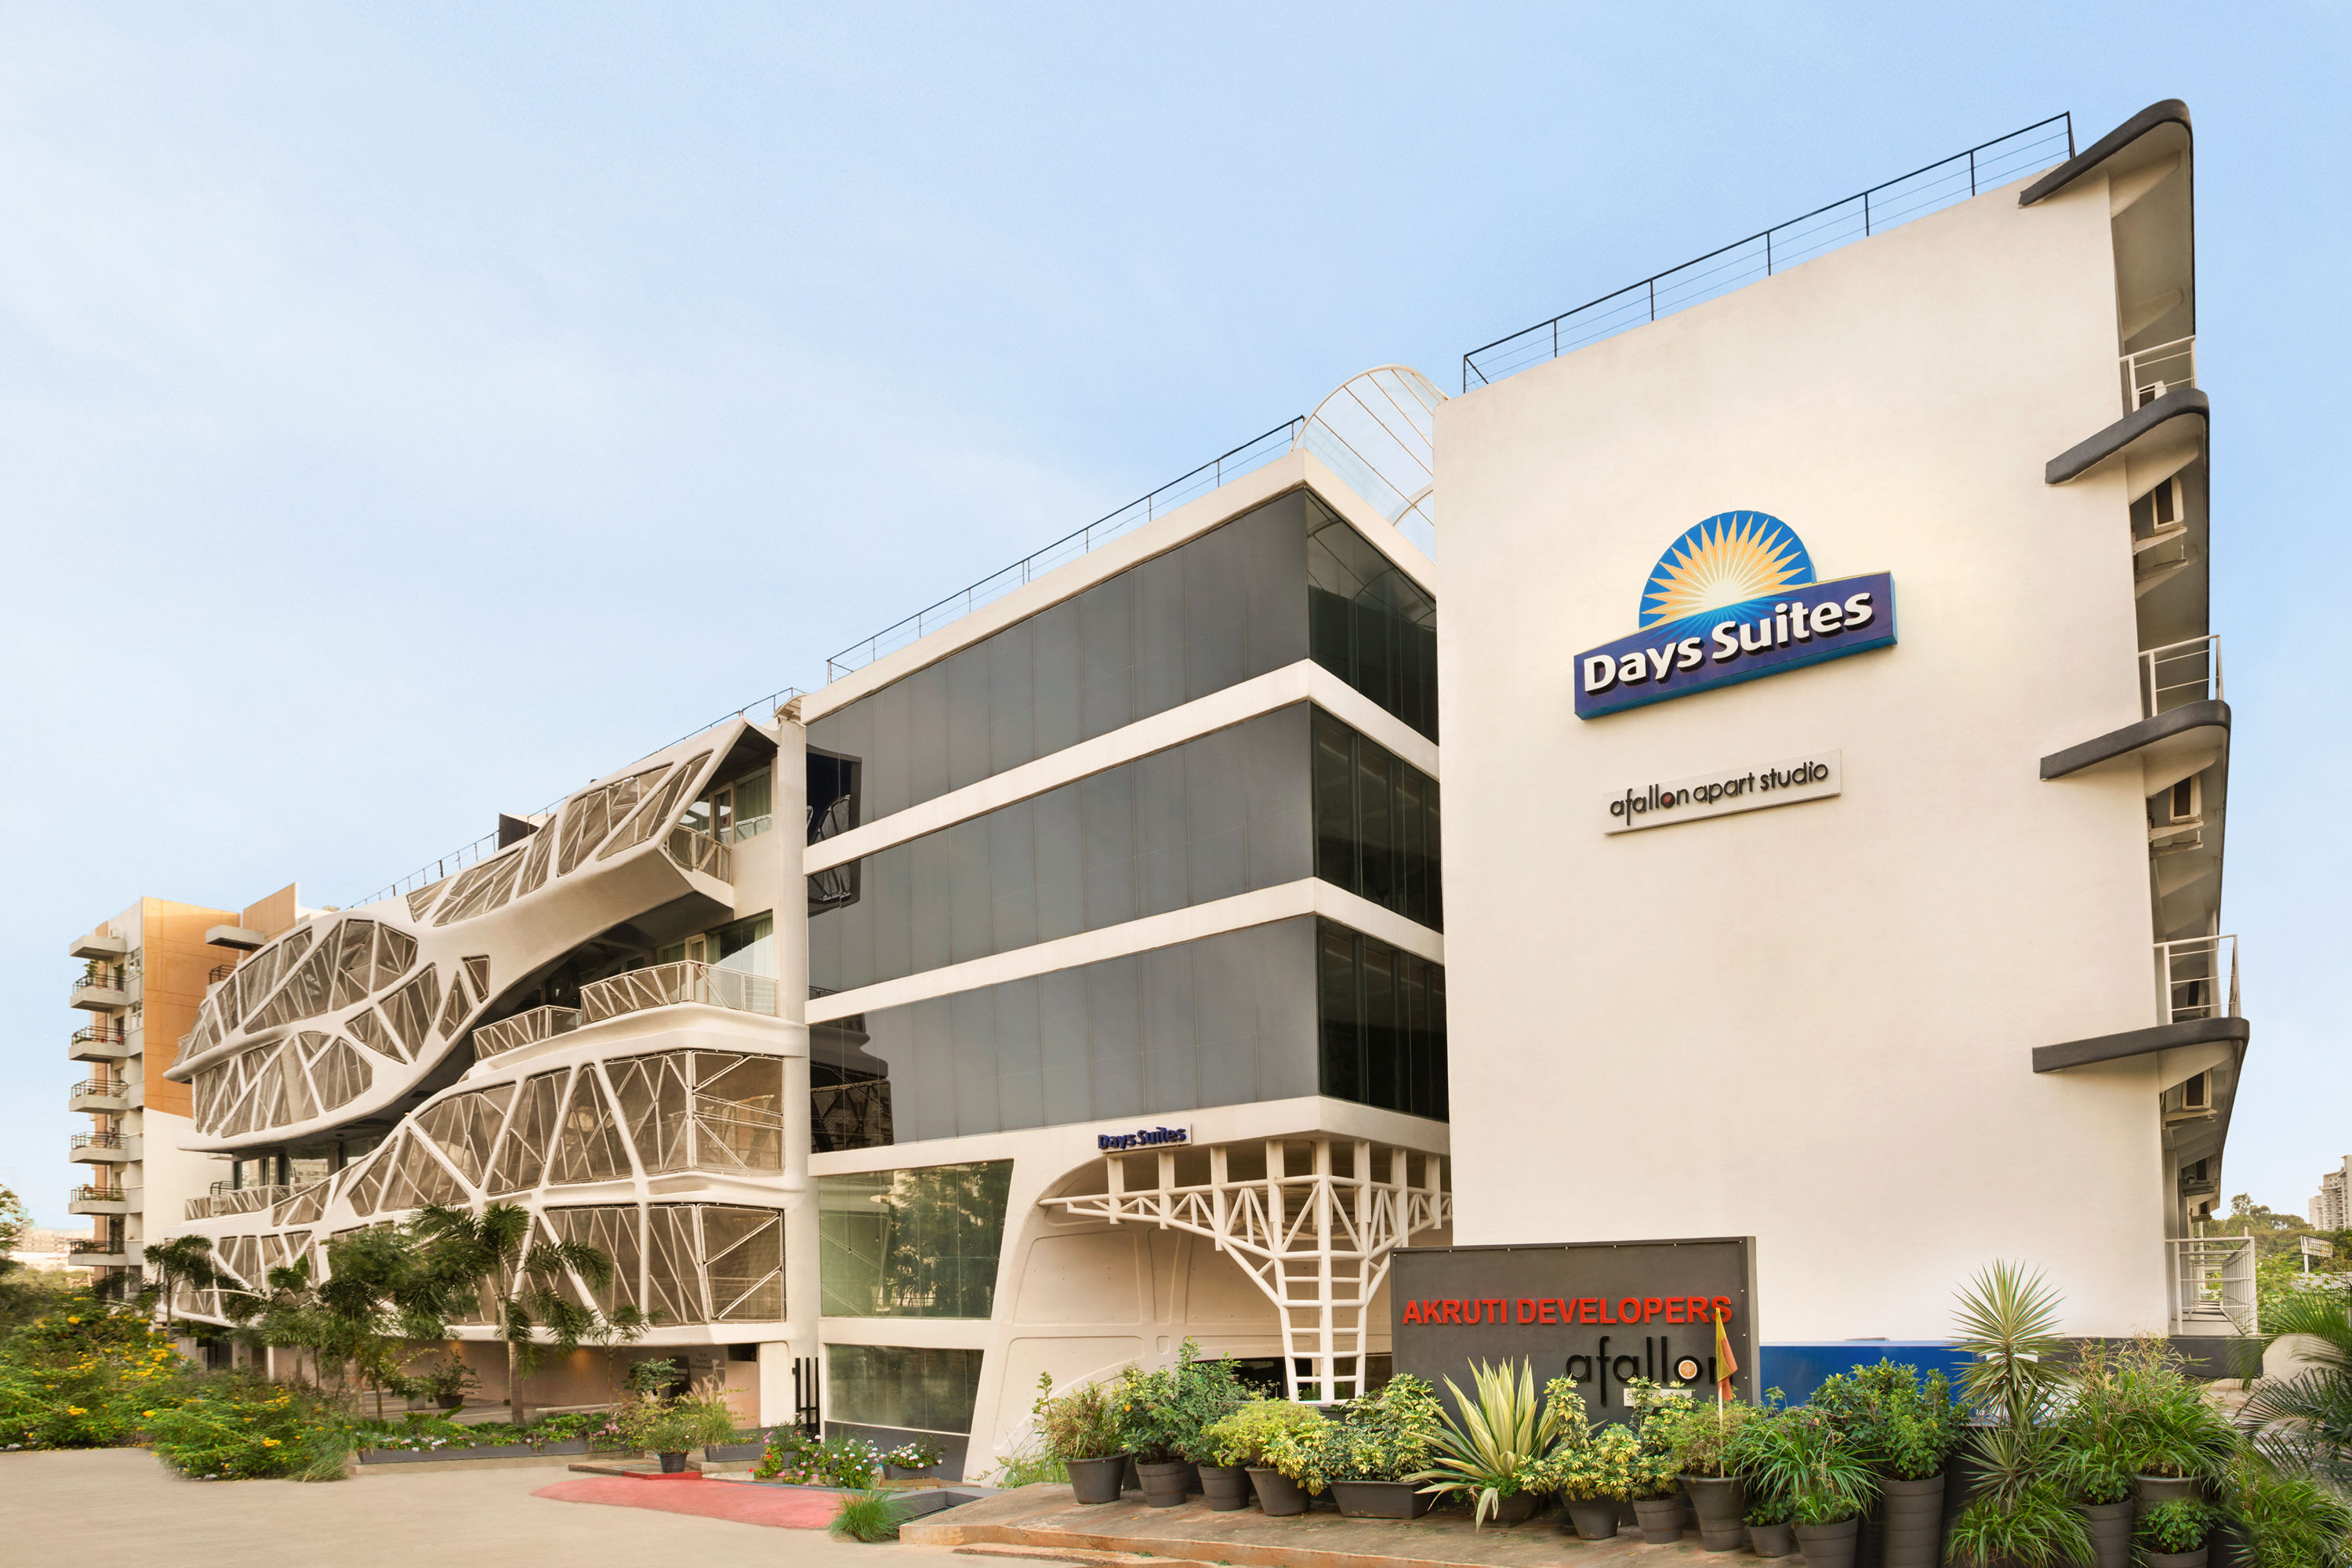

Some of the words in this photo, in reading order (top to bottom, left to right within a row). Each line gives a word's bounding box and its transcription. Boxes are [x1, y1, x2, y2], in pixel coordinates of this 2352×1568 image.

[1584, 637, 1705, 695] Days
[1711, 592, 1874, 662] Suites
[1610, 784, 1689, 826] afallon
[1693, 772, 1755, 804] apart
[1760, 760, 1828, 790] studio
[1098, 1134, 1136, 1149] Days
[1137, 1127, 1186, 1145] Suites
[1403, 1298, 1507, 1324] AKRUTI
[1517, 1295, 1733, 1324] DEVELOPERS
